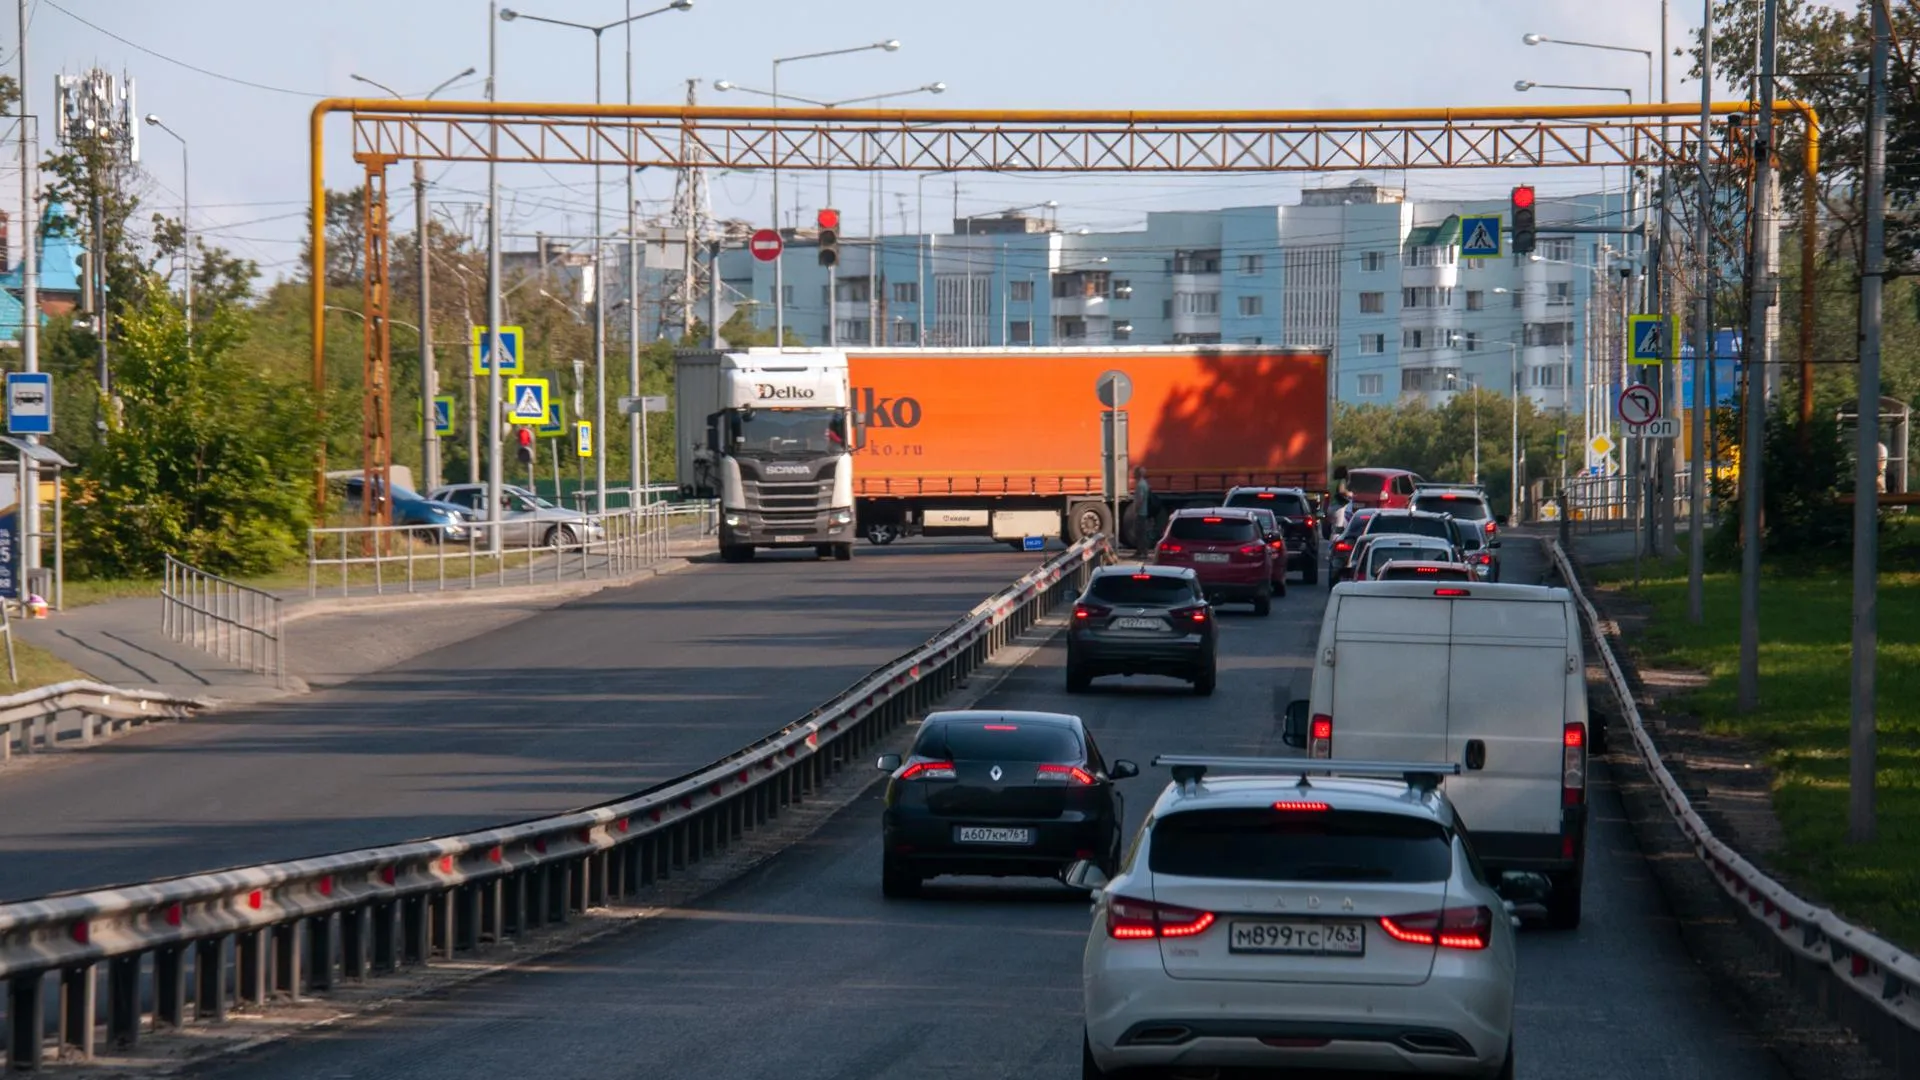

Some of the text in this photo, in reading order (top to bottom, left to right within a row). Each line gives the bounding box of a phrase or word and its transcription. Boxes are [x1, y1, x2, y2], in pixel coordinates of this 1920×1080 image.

[755, 384, 814, 399] Delko
[766, 466, 810, 474] SCANIA
[1243, 895, 1354, 911] LADA
